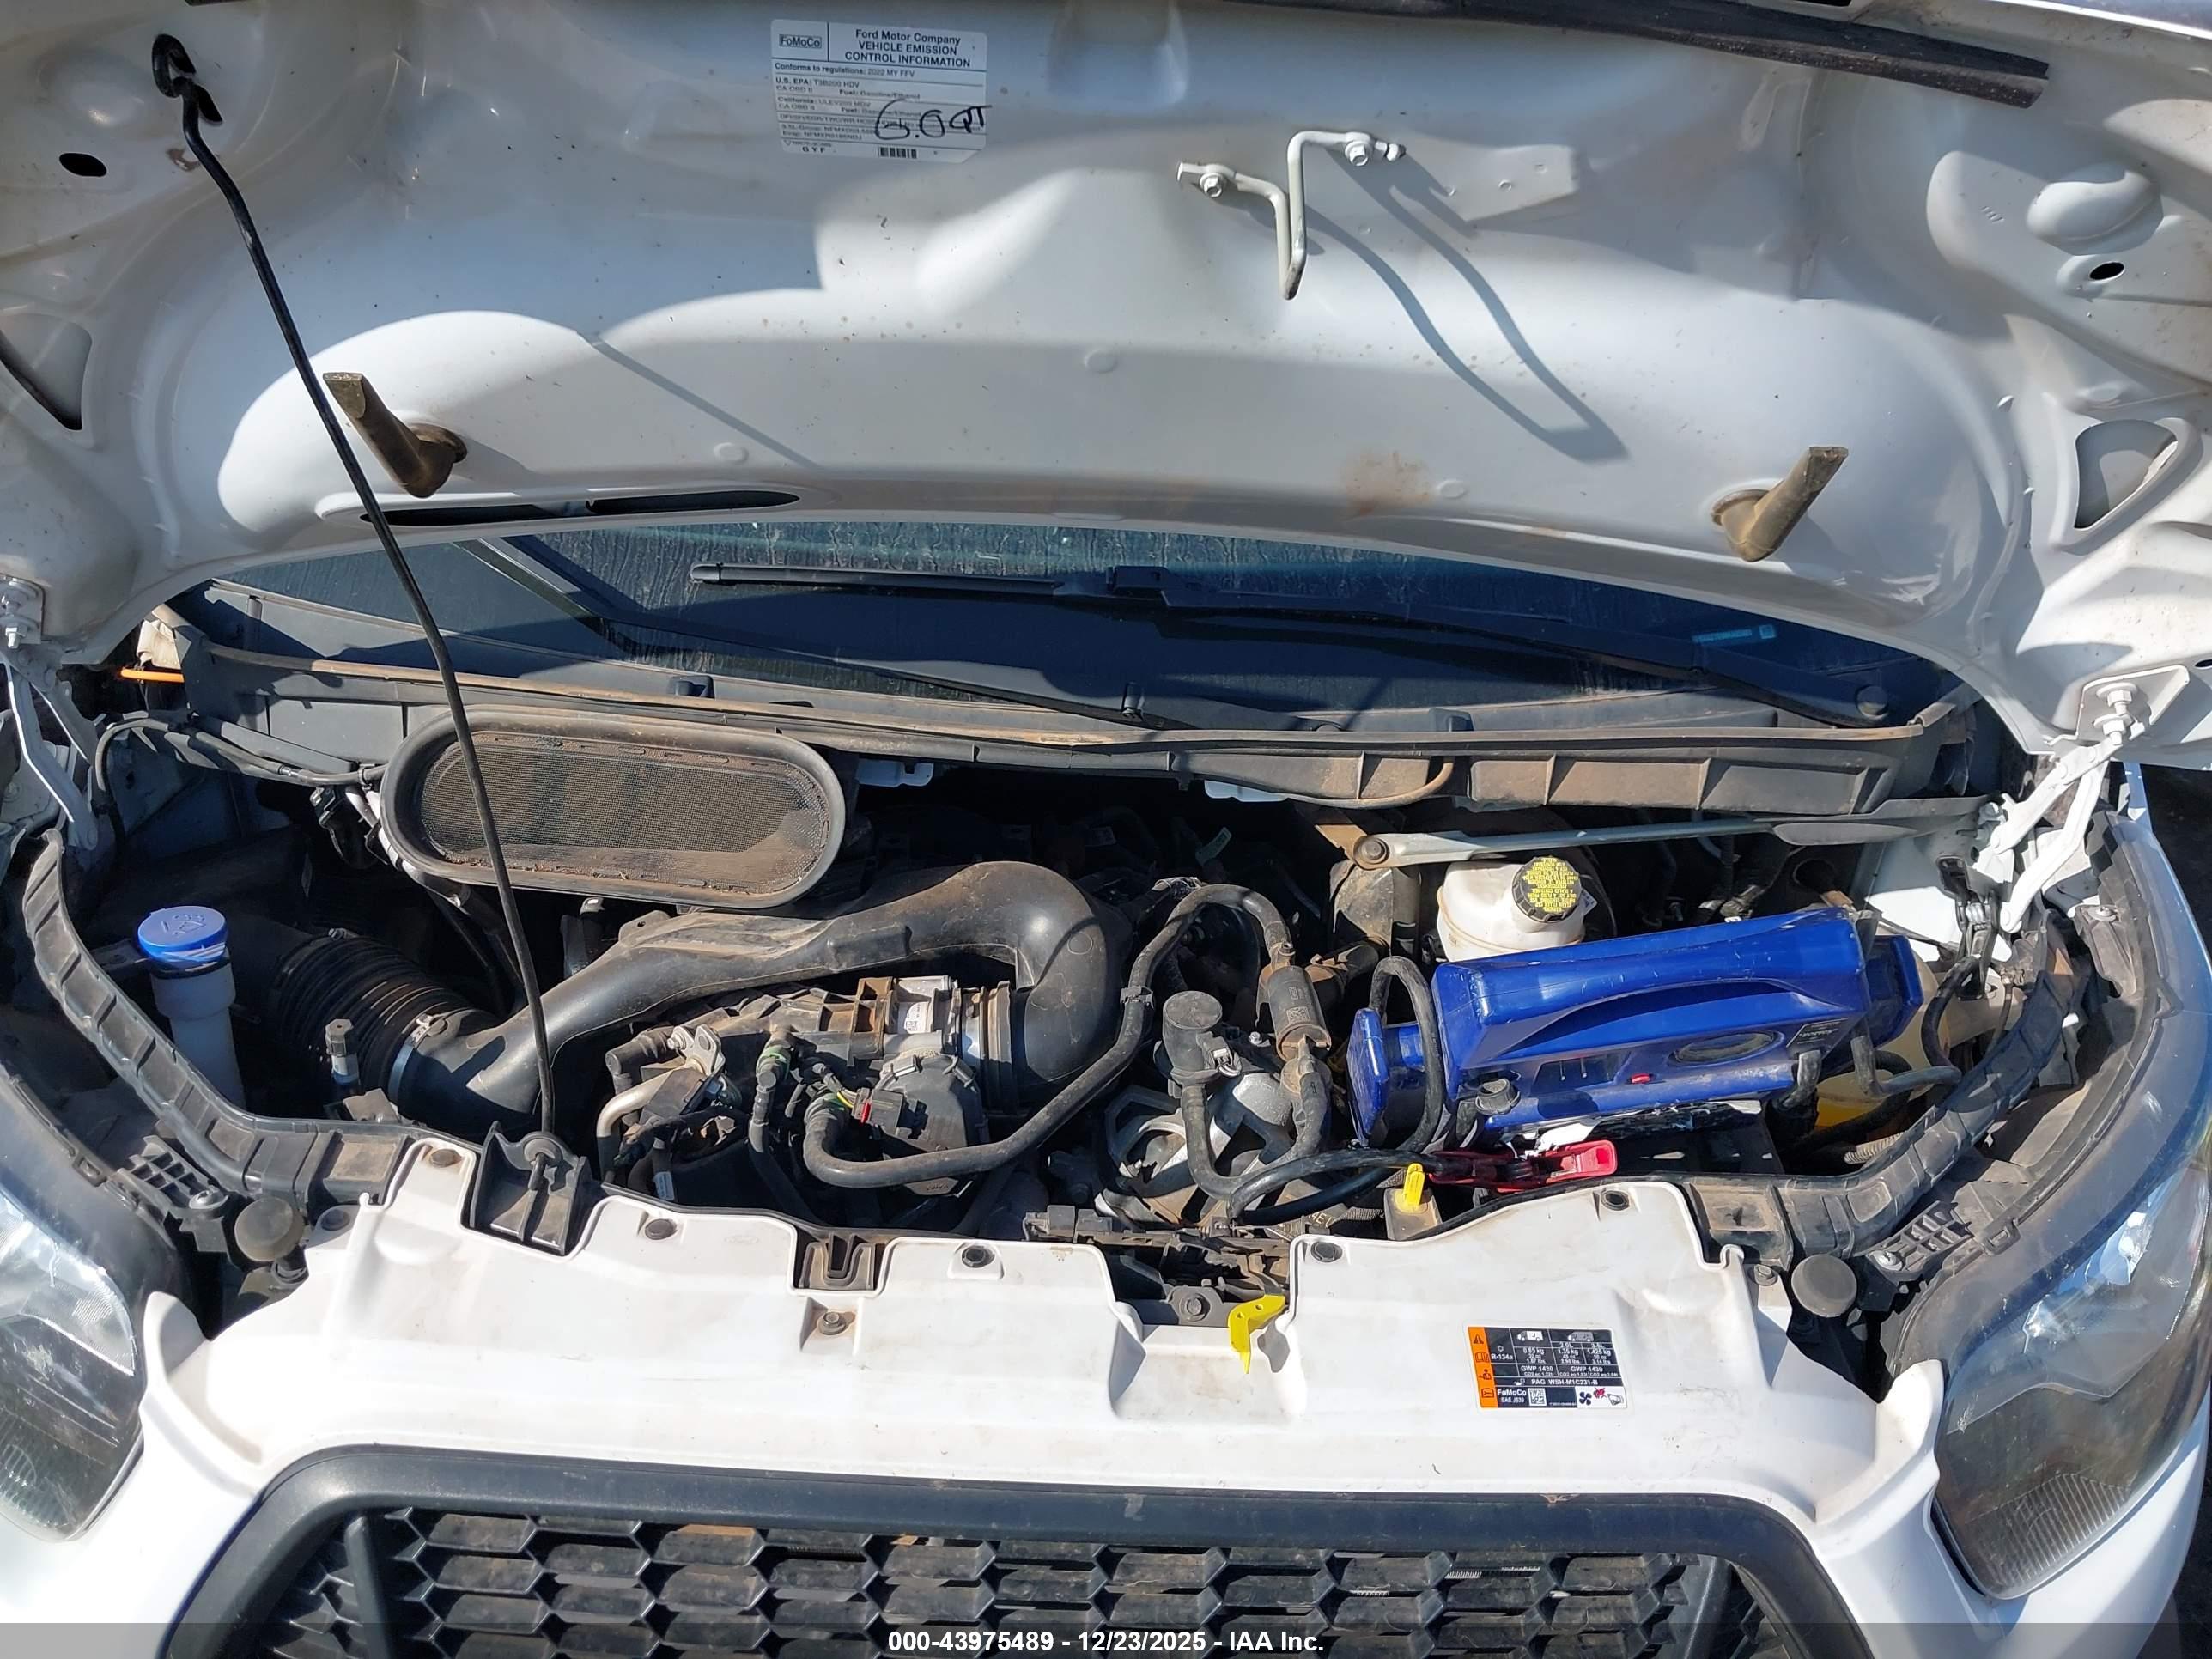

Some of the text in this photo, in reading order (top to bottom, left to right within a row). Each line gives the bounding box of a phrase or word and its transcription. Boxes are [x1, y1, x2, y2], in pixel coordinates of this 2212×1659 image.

[779, 35, 822, 48] FoMoCo
[855, 28, 961, 46] Ford Motor Company
[859, 40, 957, 55] VEHICLE EMISSION
[845, 51, 970, 67] CONTROL INFORMATION
[775, 62, 811, 70] Conforms
[822, 65, 866, 74] regulations:
[887, 69, 898, 77] MY
